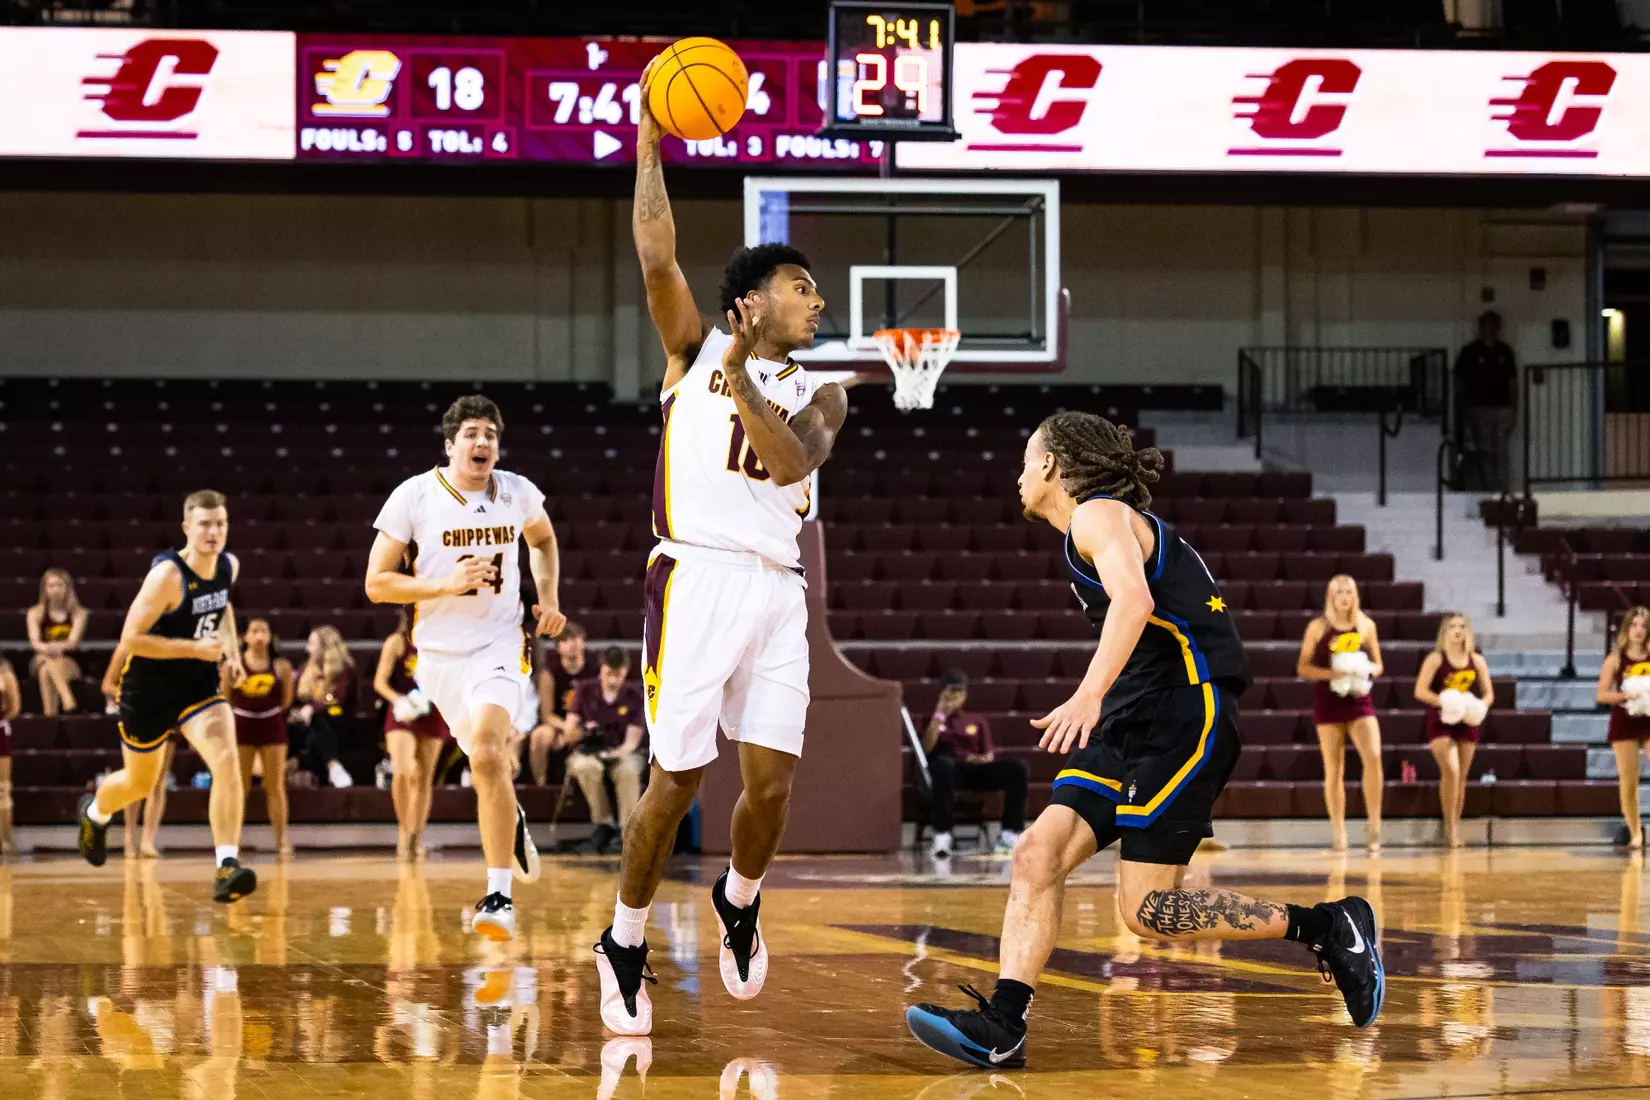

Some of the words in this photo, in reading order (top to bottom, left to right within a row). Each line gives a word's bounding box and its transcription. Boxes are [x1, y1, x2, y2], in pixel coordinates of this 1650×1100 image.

[866, 14, 940, 50] 7:41
[427, 66, 485, 111] 18
[852, 53, 928, 116] 29
[547, 81, 641, 125] 7:41
[300, 127, 387, 152] FOULS:
[427, 129, 483, 154] TOL:
[775, 134, 861, 159] FOULS:
[442, 525, 515, 547] CHIPPEWAS
[193, 612, 218, 639] 15
[1140, 893, 1159, 920] WE
[1156, 894, 1177, 932] THEM
[1176, 899, 1194, 930] ONES
